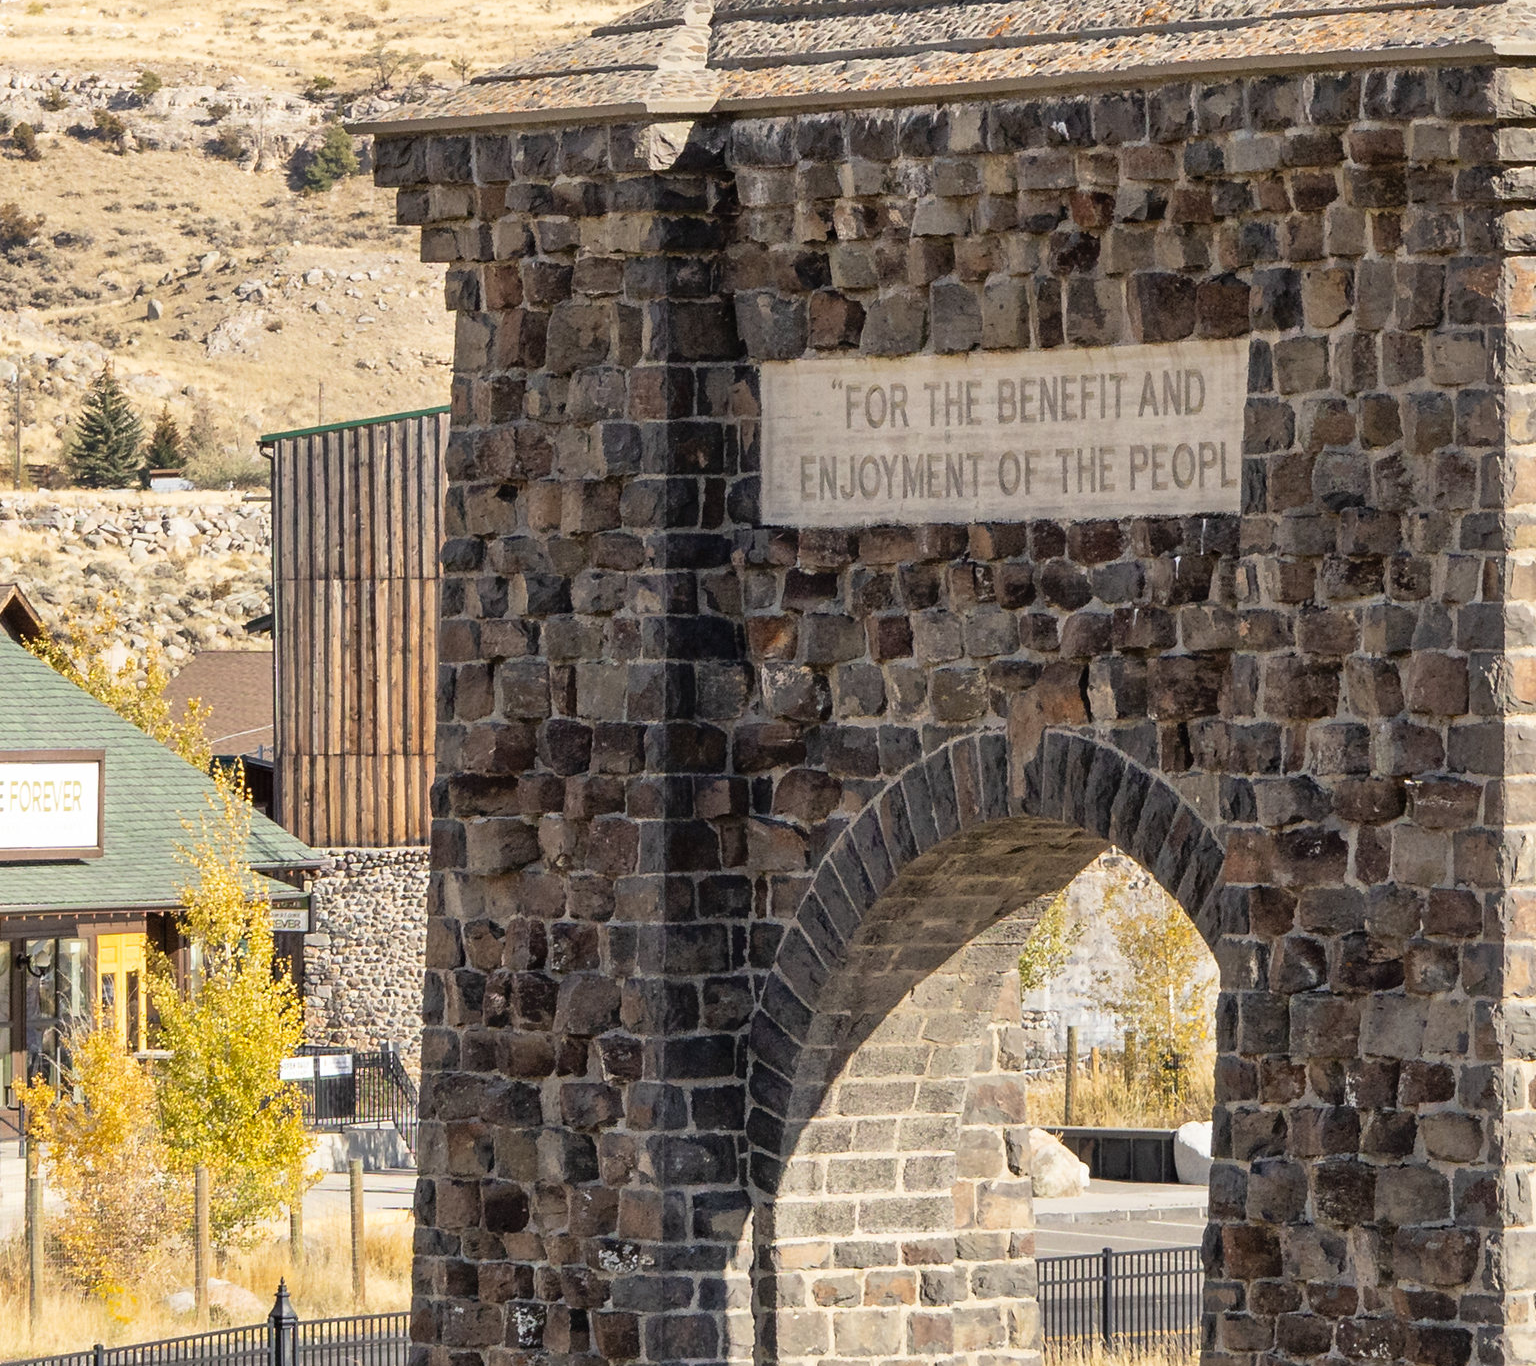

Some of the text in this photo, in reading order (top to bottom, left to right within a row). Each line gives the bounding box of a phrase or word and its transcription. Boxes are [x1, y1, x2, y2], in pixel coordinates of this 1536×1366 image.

[923, 379, 982, 426] THE
[997, 372, 1127, 425] BENEFIT
[1137, 369, 1206, 417] AND
[800, 442, 1237, 501] ENJOYMENT OF THE PEOPL
[10, 780, 83, 813] FOREVER
